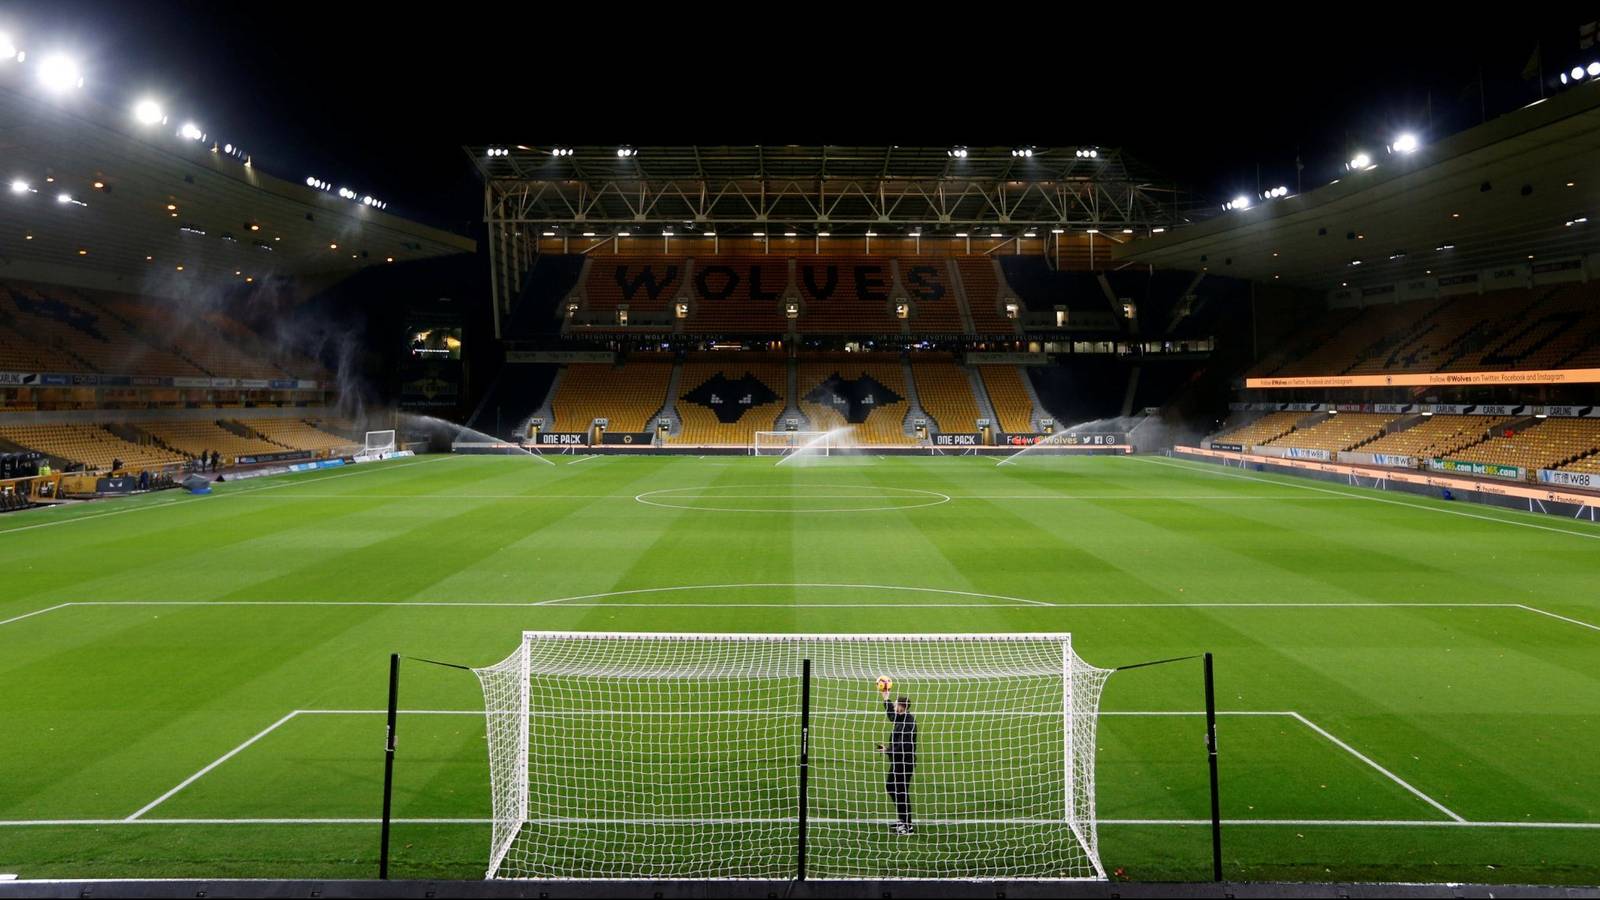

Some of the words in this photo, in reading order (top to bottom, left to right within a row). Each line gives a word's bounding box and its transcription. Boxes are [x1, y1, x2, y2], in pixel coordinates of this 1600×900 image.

[616, 265, 946, 300] WOLVES
[1446, 375, 1472, 383] @Wolves
[1525, 373, 1536, 381] and
[1537, 372, 1565, 381] Instagram
[1482, 406, 1505, 415] CARLING
[1549, 406, 1572, 416] CARLING
[543, 434, 559, 444] ONE
[560, 434, 581, 444] PACK
[937, 435, 953, 445] ONE
[954, 435, 975, 445] PACK
[1433, 460, 1472, 473] bet365.com
[1472, 464, 1517, 478] bet365.com
[1570, 474, 1590, 486] W88
